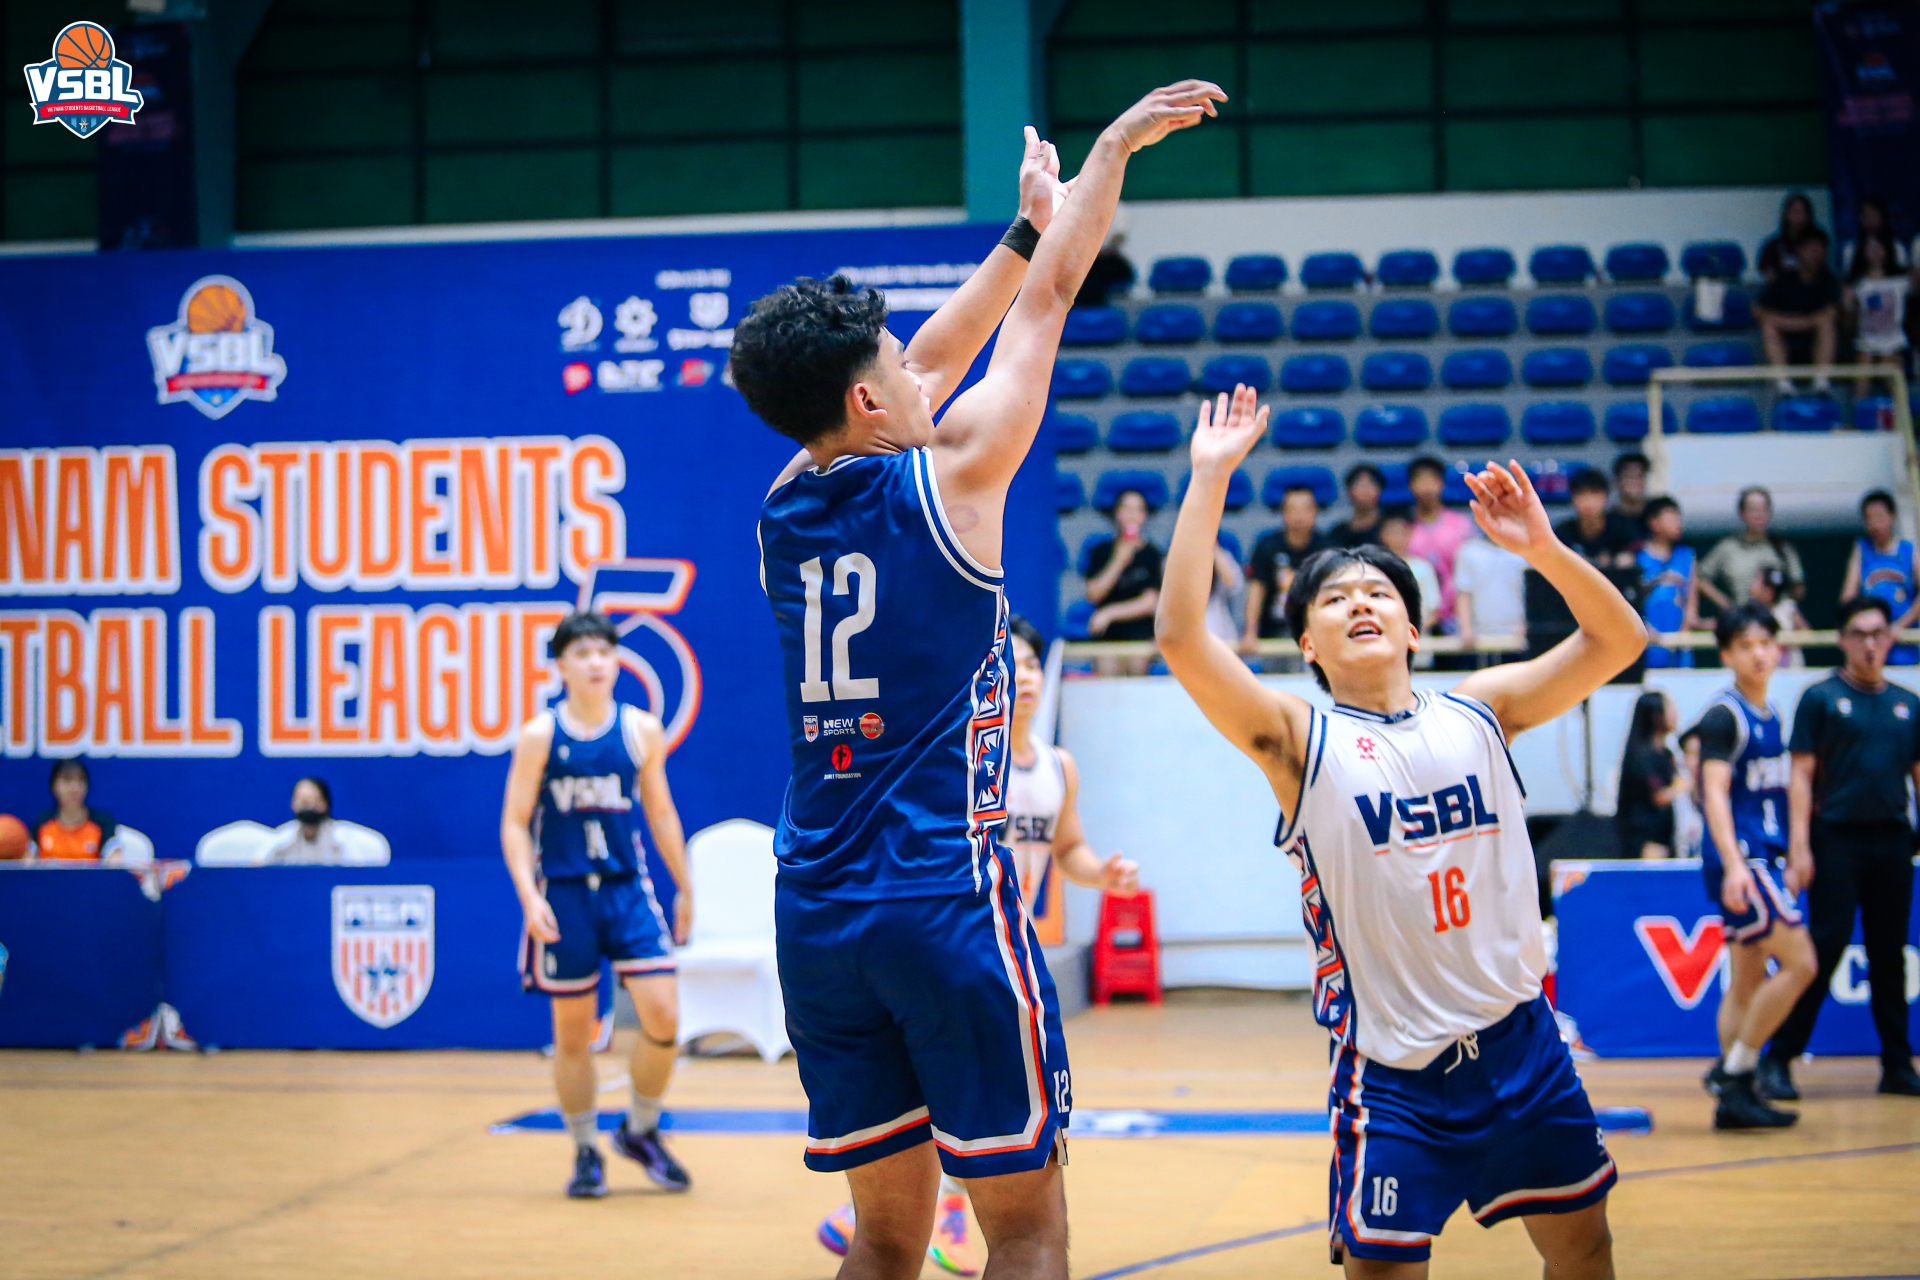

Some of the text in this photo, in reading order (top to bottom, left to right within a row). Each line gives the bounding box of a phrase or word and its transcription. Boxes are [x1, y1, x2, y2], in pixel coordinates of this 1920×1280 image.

[199, 436, 626, 594] STUDENTS
[799, 552, 880, 702] 12
[823, 728, 856, 736] SPORTS
[1354, 775, 1499, 846] VSBL
[1427, 866, 1472, 933] 16
[1053, 1069, 1070, 1113] 12
[1371, 1176, 1399, 1216] 16
